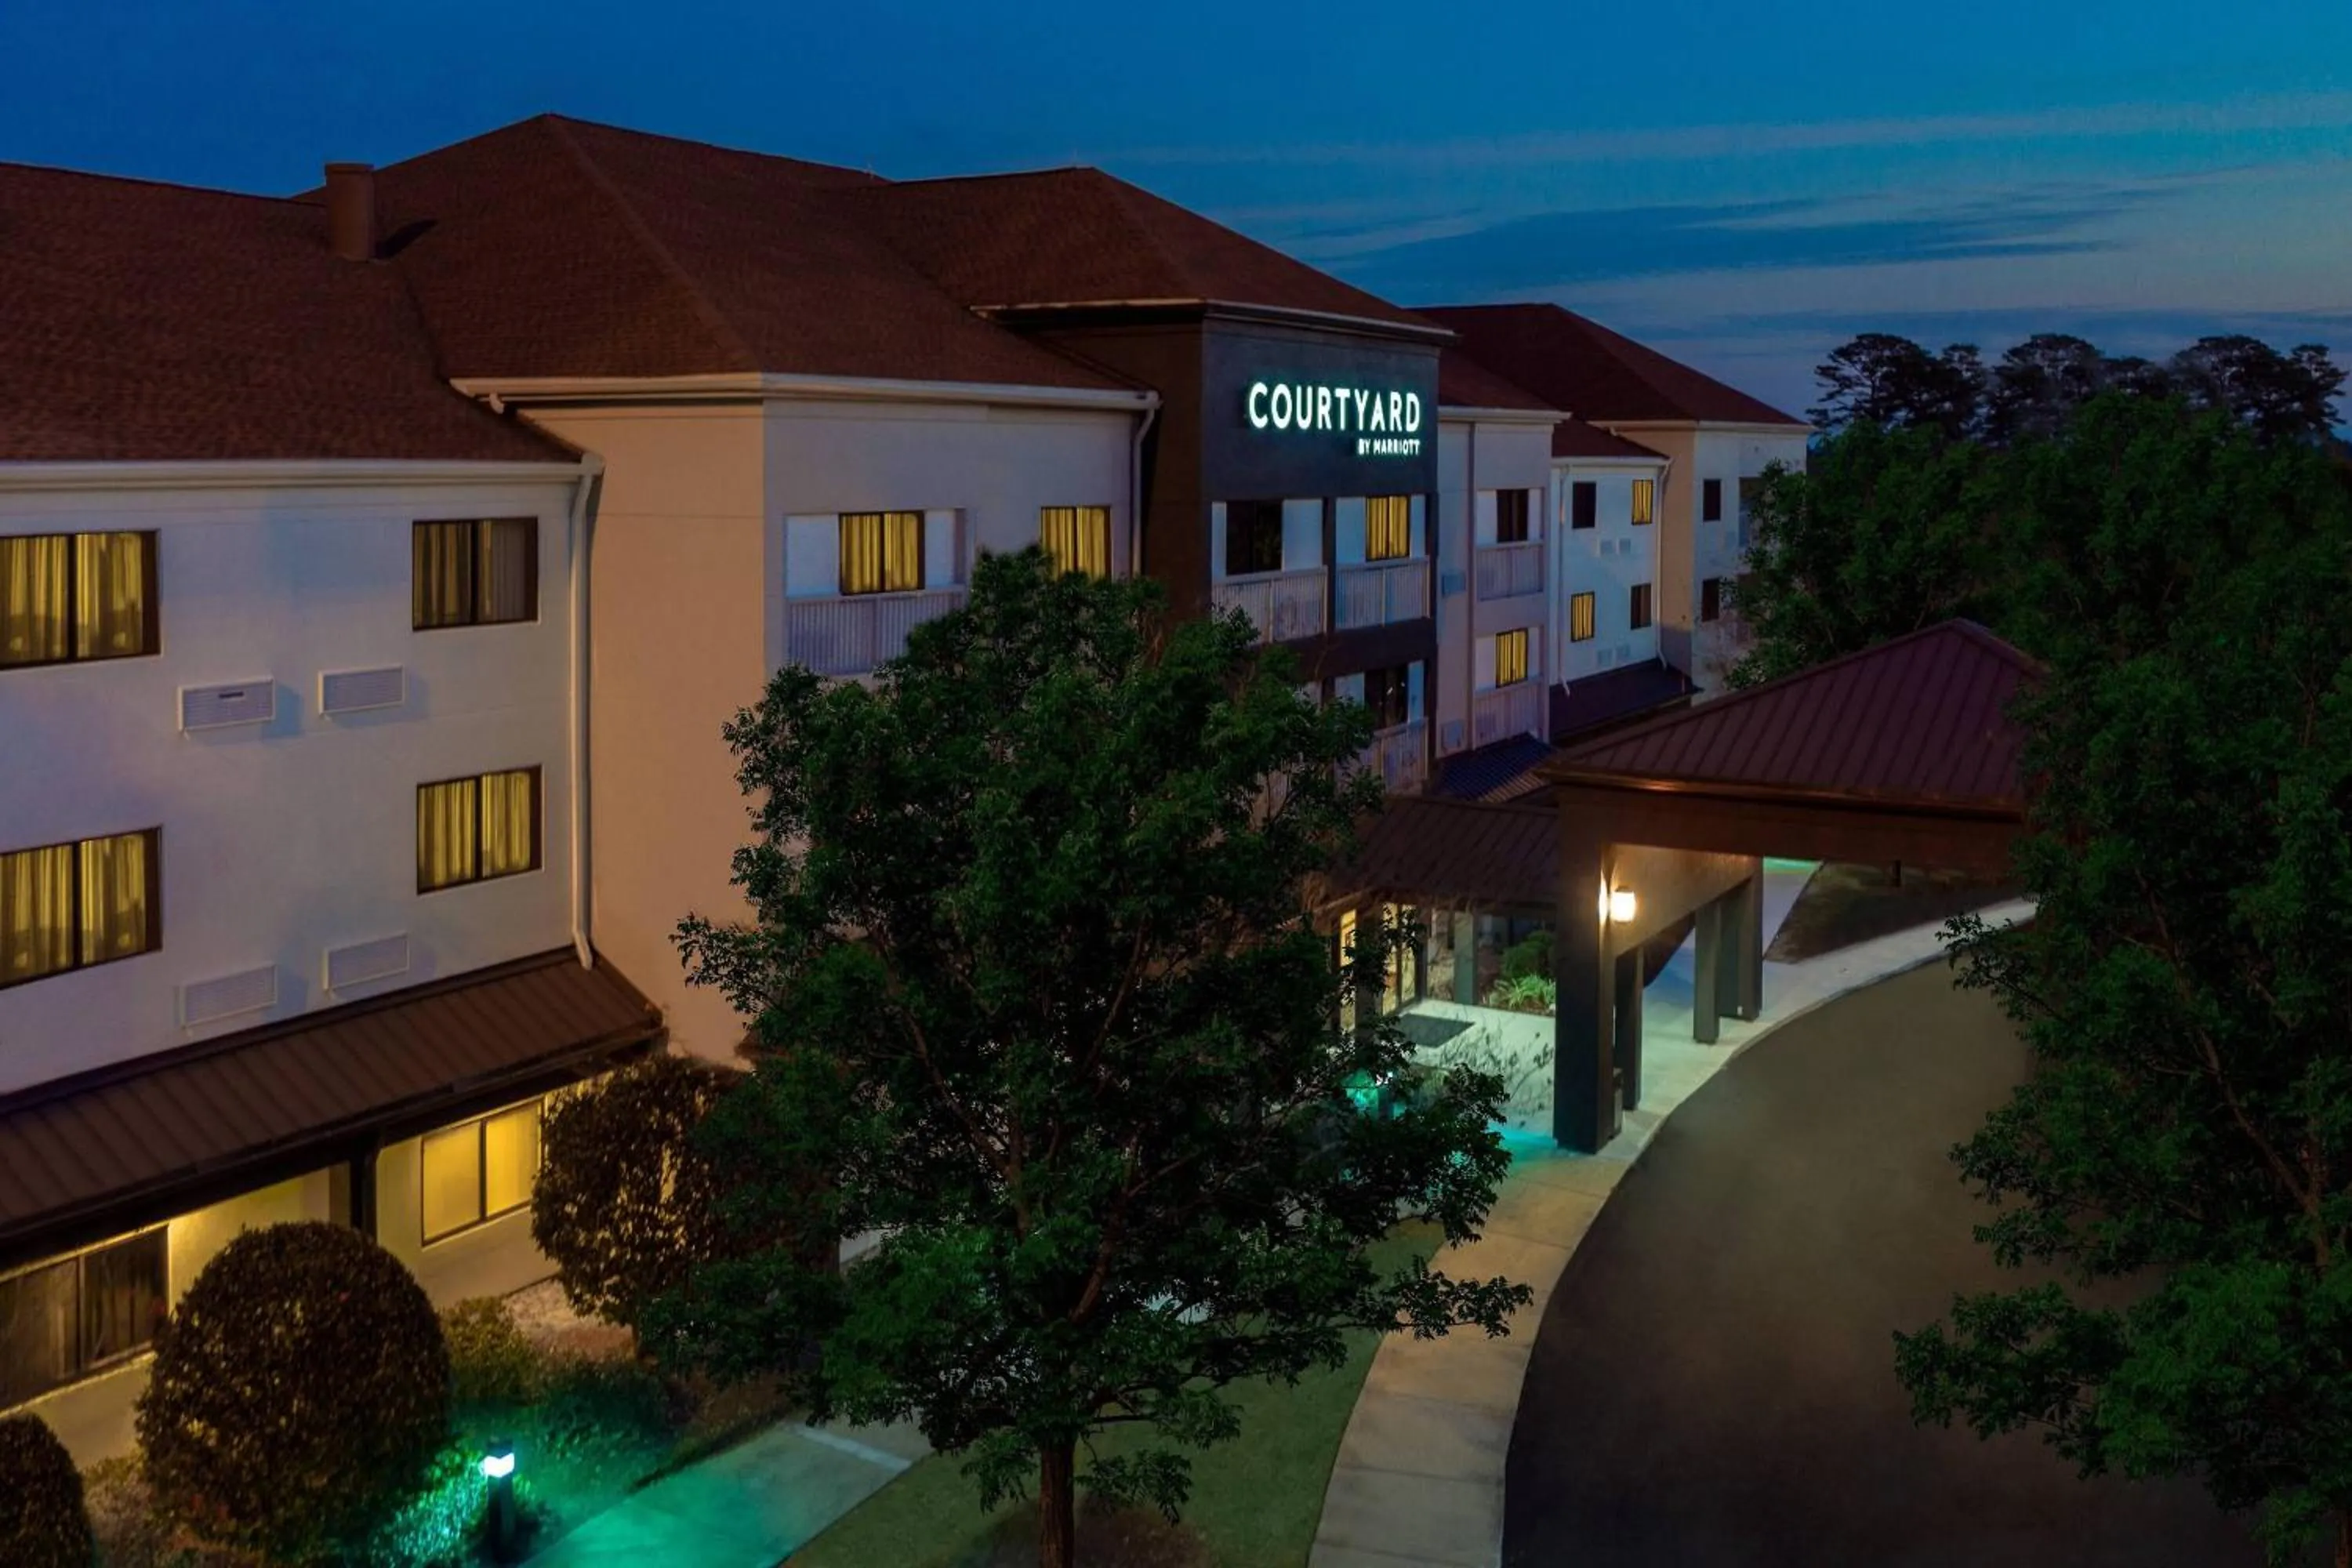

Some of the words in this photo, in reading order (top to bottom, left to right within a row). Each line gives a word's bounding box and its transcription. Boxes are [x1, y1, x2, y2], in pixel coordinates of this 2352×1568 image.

[1249, 382, 1420, 432] COURTYARD
[1358, 438, 1370, 455] BY
[1373, 438, 1421, 455] MARRIOTT
